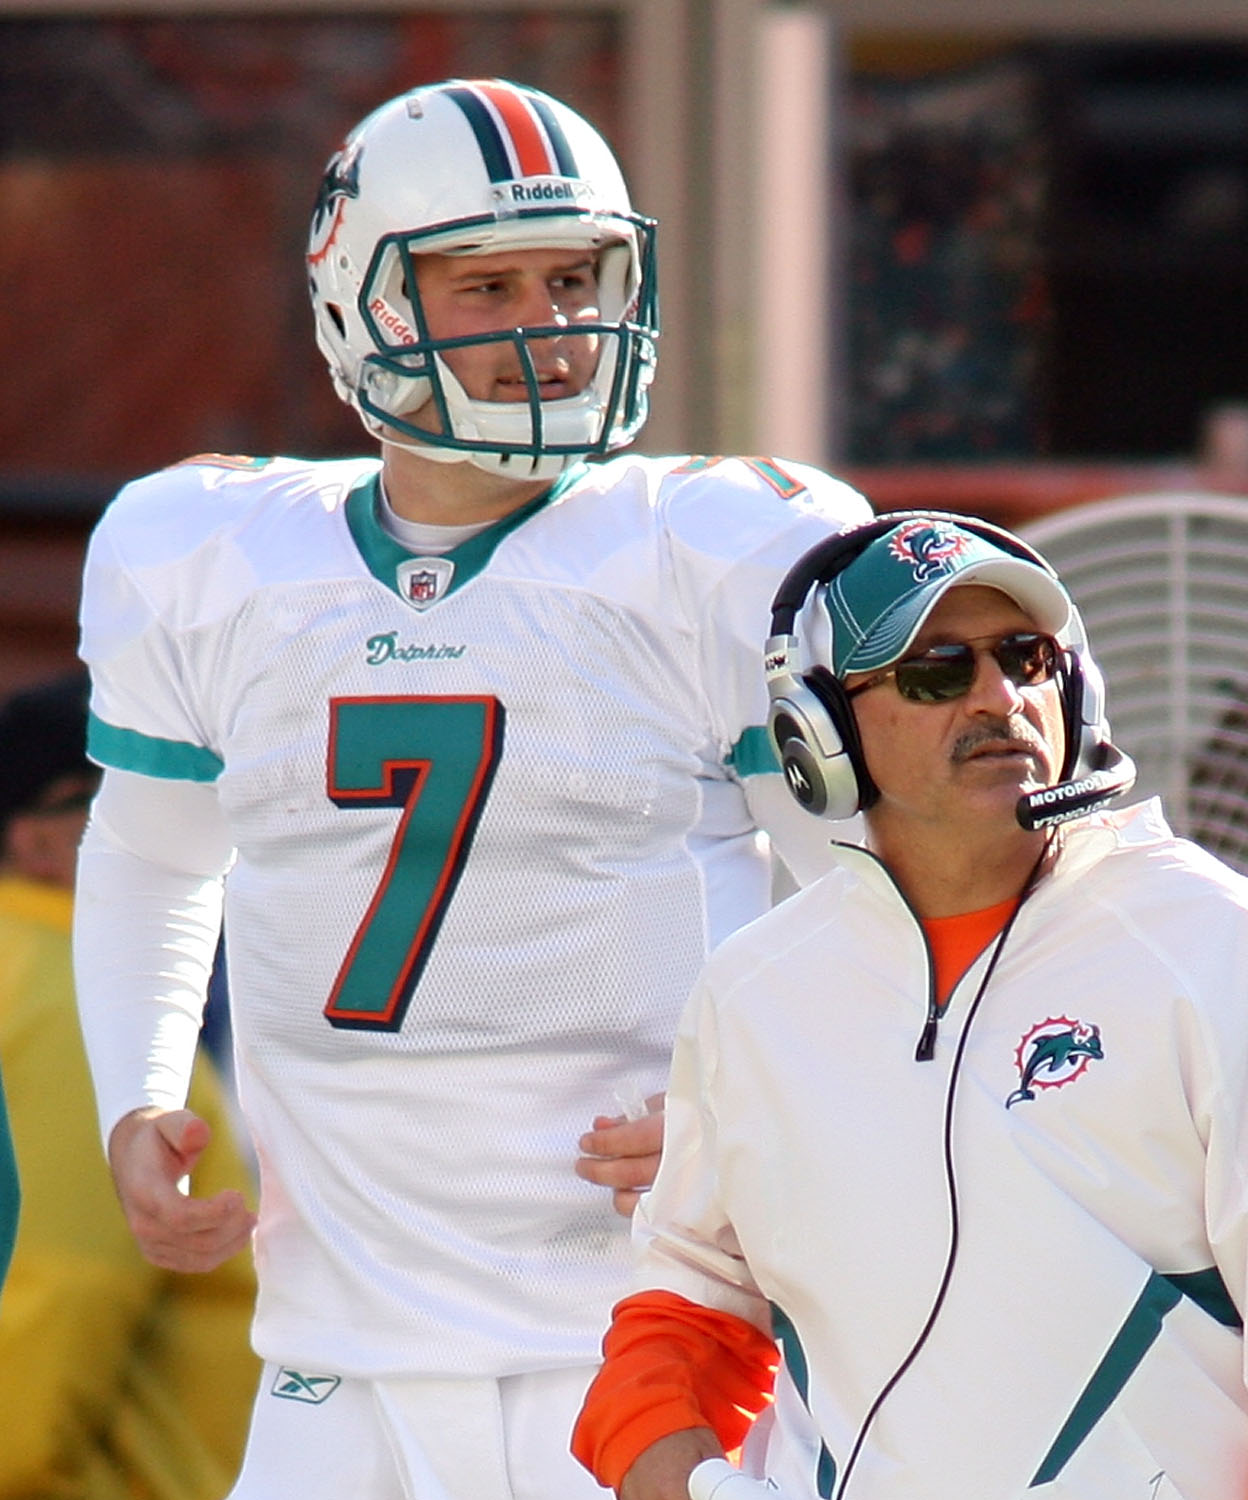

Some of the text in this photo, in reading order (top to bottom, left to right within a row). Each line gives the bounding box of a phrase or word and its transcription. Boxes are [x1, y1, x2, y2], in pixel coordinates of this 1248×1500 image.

[511, 184, 575, 201] Riddell
[370, 298, 415, 346] Ridde
[366, 630, 467, 666] Dolphins
[1028, 775, 1106, 808] MOTOROL
[323, 694, 506, 1033] 7
